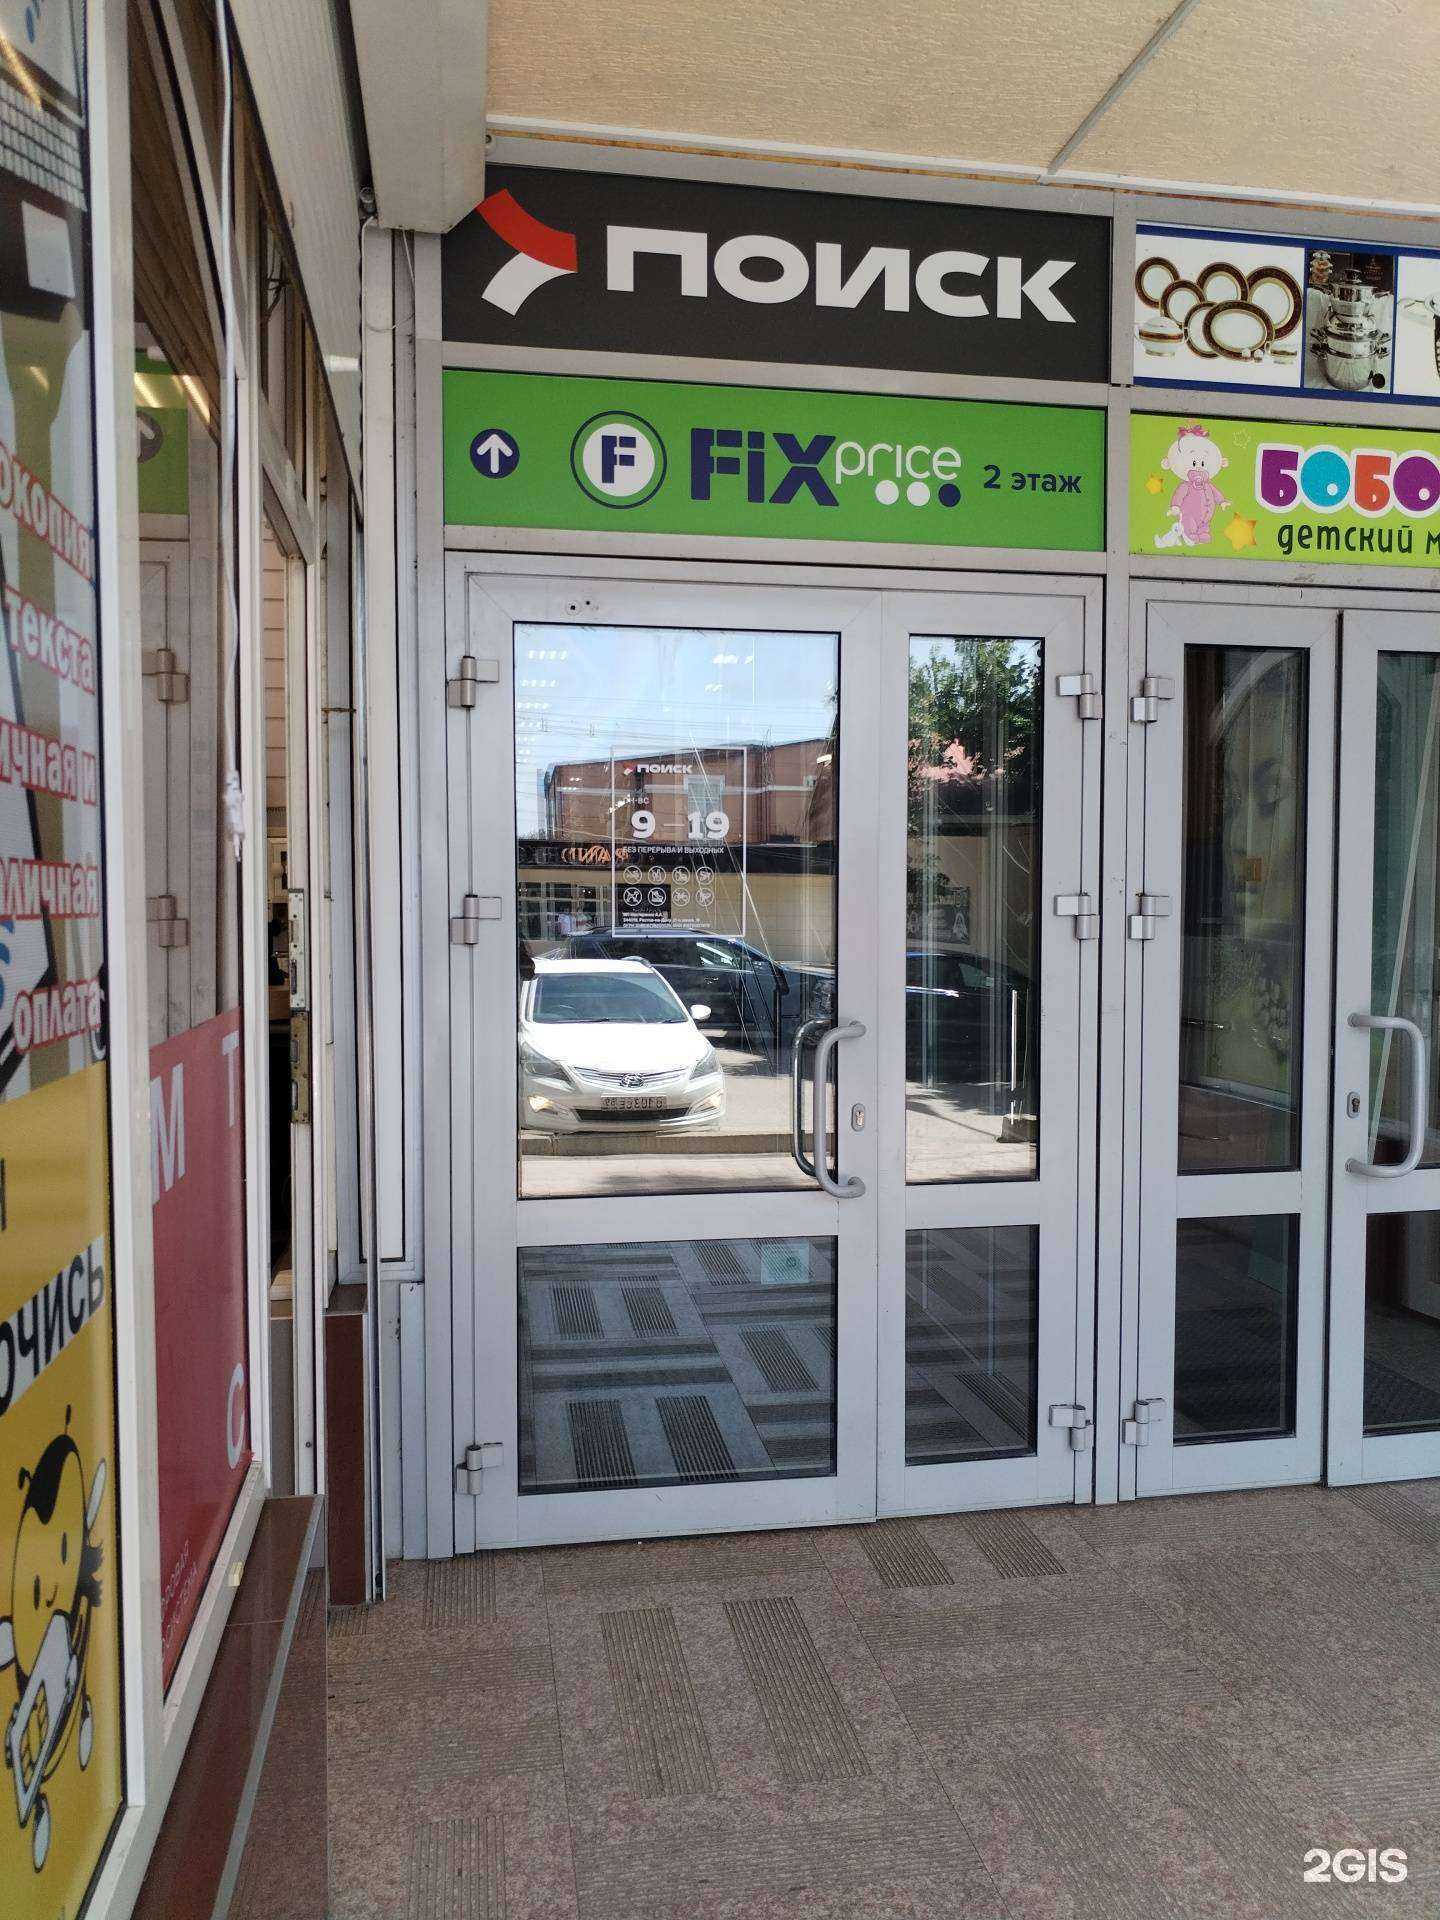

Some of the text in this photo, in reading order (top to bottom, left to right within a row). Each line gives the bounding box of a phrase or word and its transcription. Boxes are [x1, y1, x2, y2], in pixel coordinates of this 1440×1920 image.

[606, 225, 1077, 323] ПОИСК
[835, 441, 962, 485] price
[983, 464, 1083, 494] 2 этаж
[1277, 523, 1413, 555] детский
[3, 586, 96, 694] текста
[637, 764, 694, 774] ПОИСК
[631, 810, 656, 839] 9
[687, 810, 730, 839] 19
[684, 846, 725, 854] ВЫХОДНЫХ
[0, 858, 99, 919] личная
[13, 978, 102, 1054] оплата
